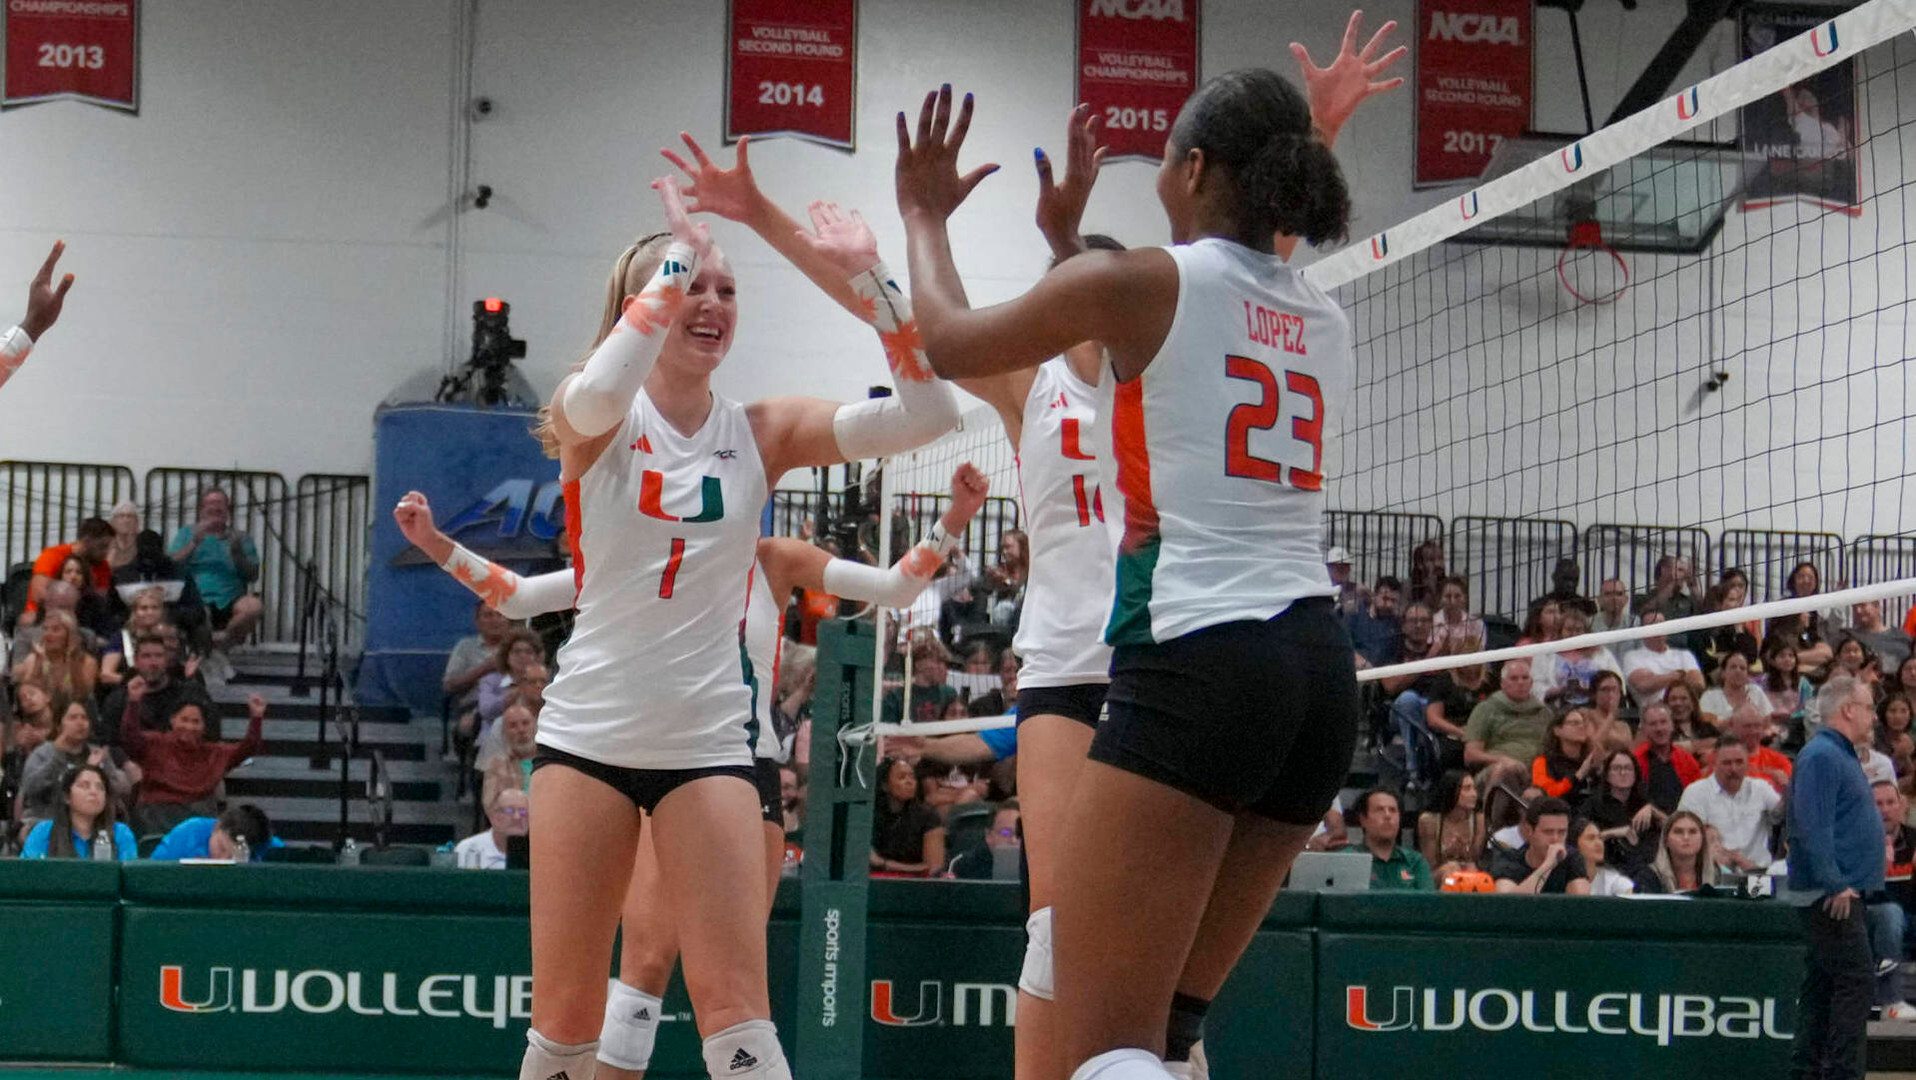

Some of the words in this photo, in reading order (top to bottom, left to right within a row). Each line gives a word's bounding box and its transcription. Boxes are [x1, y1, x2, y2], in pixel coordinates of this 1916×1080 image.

[9, 0, 129, 16] CHAMPIONSHIPS
[1089, 0, 1185, 21] NCAA
[751, 26, 831, 43] VOLLEYBALL
[1428, 11, 1519, 46] NCAA
[38, 43, 104, 69] 2013
[738, 40, 793, 54] SECOND
[795, 43, 843, 57] ROUND
[1098, 53, 1174, 69] VOLLEYBALL
[1083, 65, 1188, 83] CHAMPIONSHIPS
[1437, 76, 1511, 93] VOLLEYBALL
[758, 81, 824, 106] 2014
[1425, 89, 1476, 104] SECOND
[1477, 93, 1522, 107] ROUND
[1105, 106, 1168, 131] 2015
[1443, 130, 1504, 155] 2017
[1244, 301, 1307, 355] LOPEZ
[1225, 353, 1325, 492] 23
[638, 469, 725, 524] U
[658, 537, 686, 600] 1
[825, 908, 840, 961] sports
[159, 965, 233, 1013] U
[242, 968, 676, 1030] VOLLEYB
[821, 962, 837, 1027] imports
[871, 980, 942, 1027] U
[1346, 985, 1414, 1031] U
[1423, 988, 1798, 1046] VOLLEYBAL
